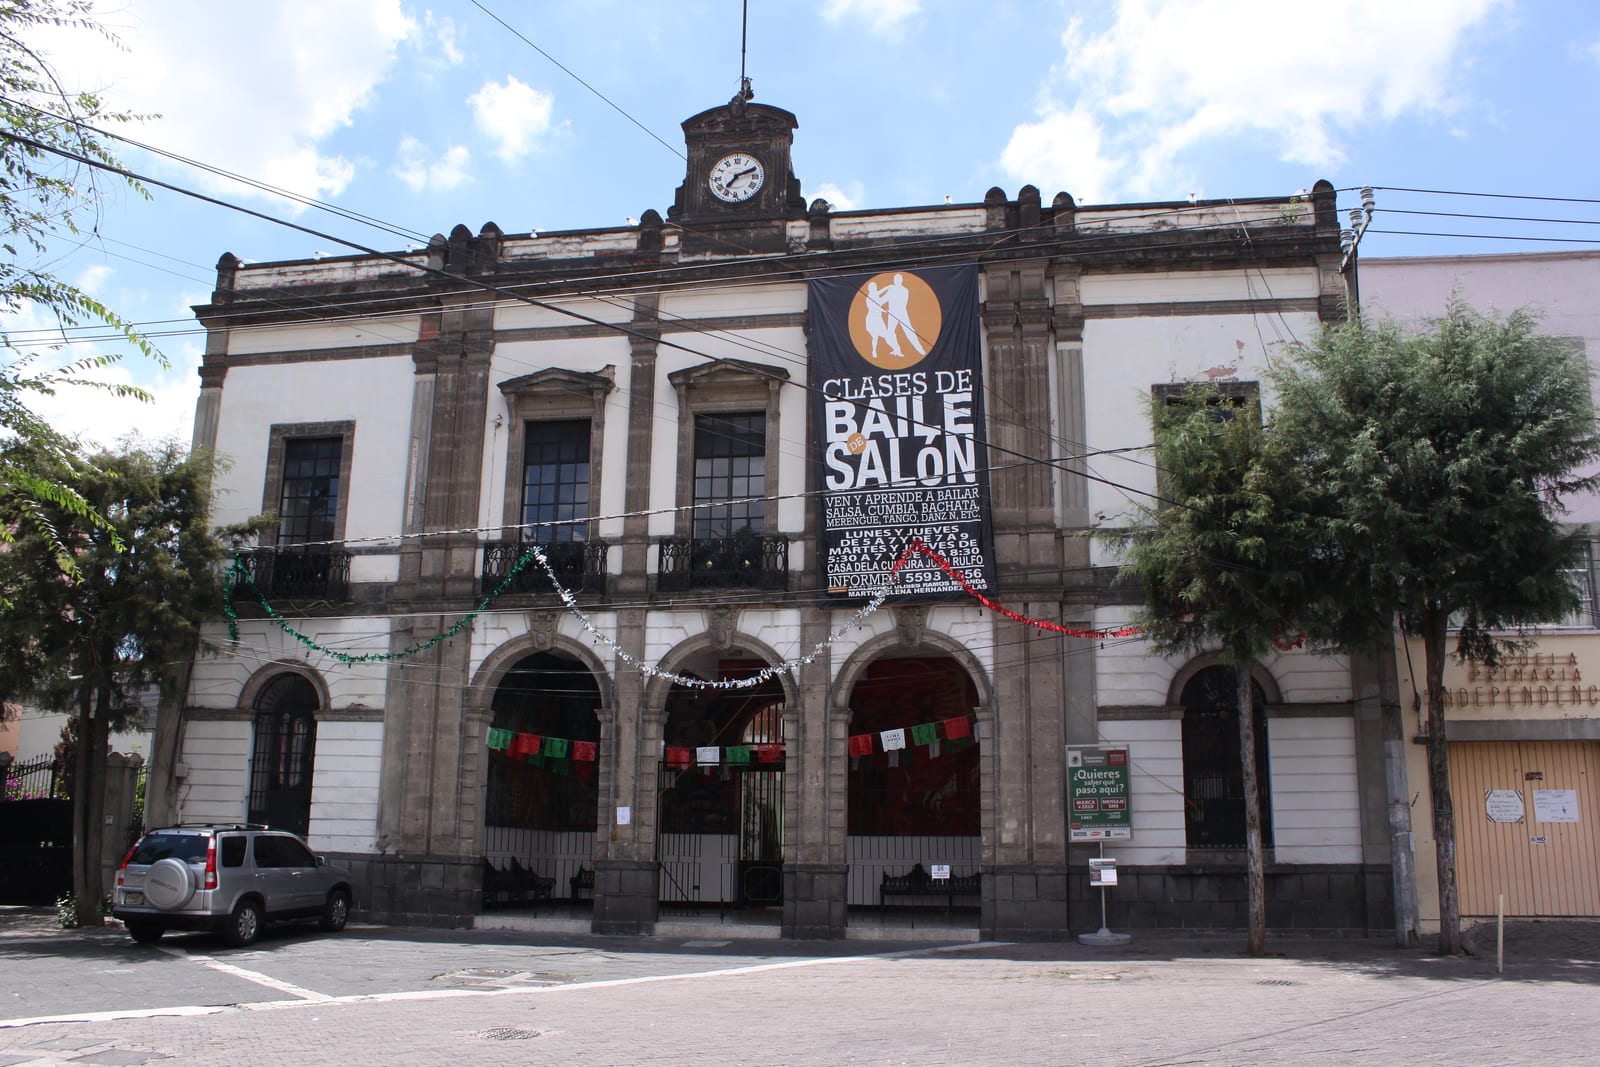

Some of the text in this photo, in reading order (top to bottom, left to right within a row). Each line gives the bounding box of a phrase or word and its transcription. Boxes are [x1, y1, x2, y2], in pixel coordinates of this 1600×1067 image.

[823, 369, 973, 401] CLASES DE
[825, 392, 975, 443] BAILE
[849, 438, 865, 451] DE
[825, 432, 976, 490] SALÓN
[825, 487, 980, 507] VEN Y APRENDE A BAILAR
[826, 499, 980, 519] SALSA, CUMBIA, BACHATA,
[826, 514, 882, 527] MERENGUE,
[883, 512, 919, 524] TANGO,
[961, 509, 981, 519] ETC.
[840, 532, 969, 547] DE 5 A 7 Y DE 7 A 9
[845, 525, 960, 539] LUNES Y JUEVES
[827, 554, 858, 563] 5:30
[860, 553, 871, 561] A
[888, 552, 898, 560] Y
[937, 549, 947, 557] A
[949, 547, 980, 556] 8:30
[829, 539, 978, 556] MARTES Y JVES DE
[827, 563, 853, 574] CASA
[880, 558, 924, 571] CUURA
[925, 557, 951, 568] JUN
[952, 555, 984, 566] RULFO
[905, 571, 941, 583] 5593
[1469, 667, 1582, 683] PRIMARIA
[1440, 684, 1598, 708] NDEPENDENC
[1073, 769, 1120, 781] ¿Quieres
[1084, 779, 1102, 787] saber
